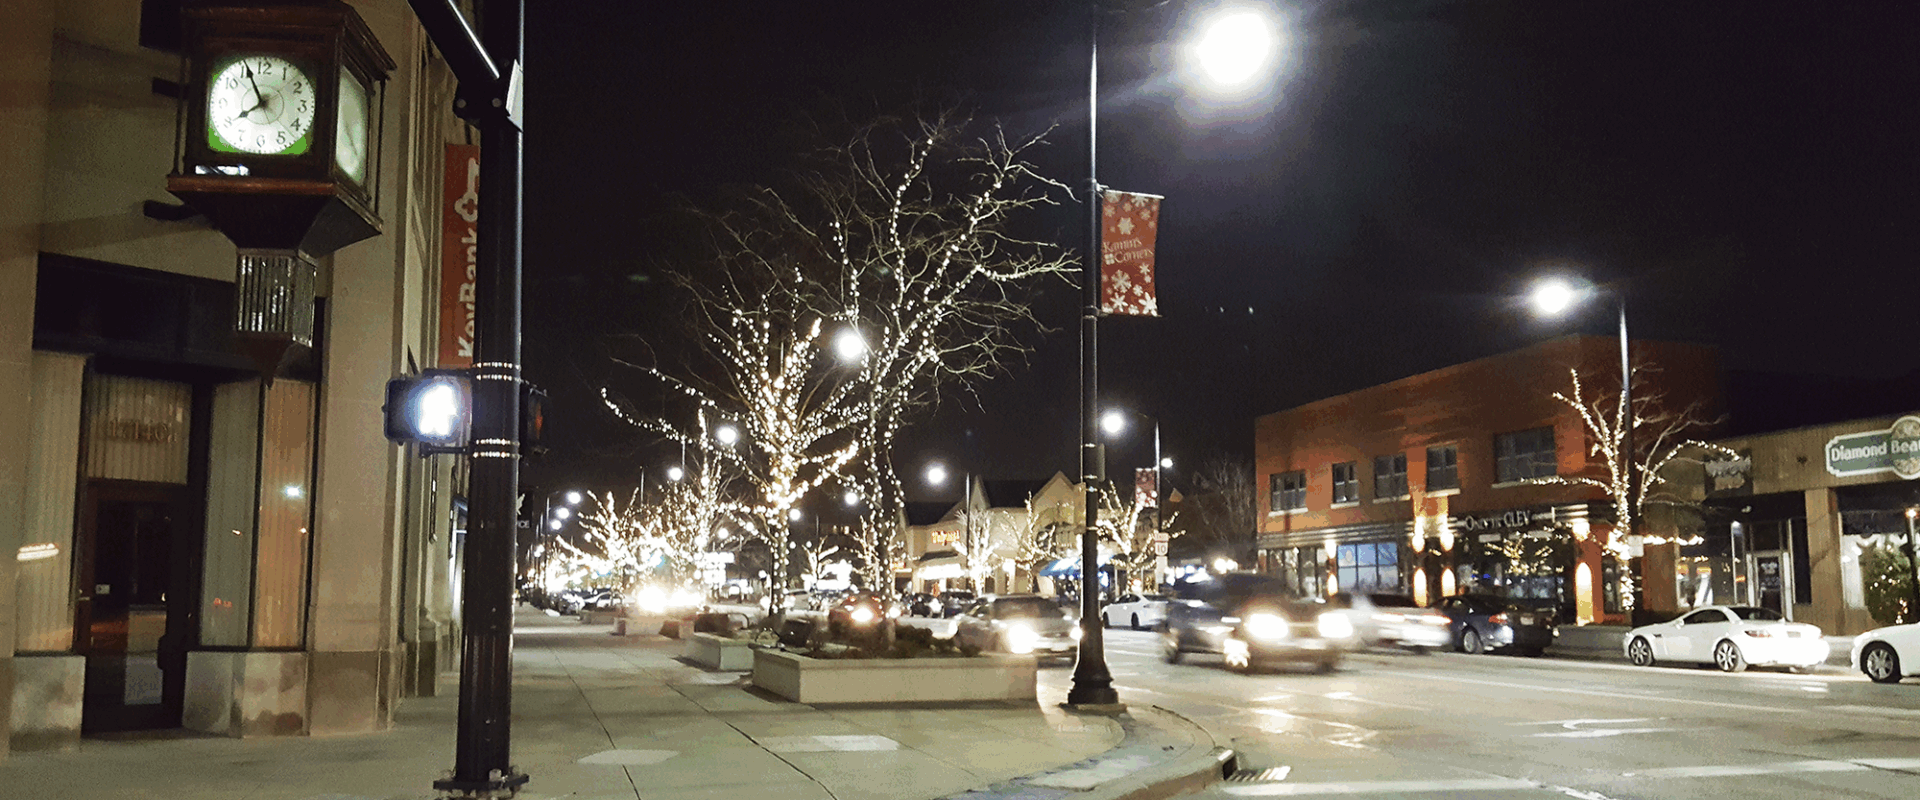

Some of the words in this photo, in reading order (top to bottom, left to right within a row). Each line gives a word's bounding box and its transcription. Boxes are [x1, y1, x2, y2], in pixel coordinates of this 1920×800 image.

[240, 65, 251, 79] 1
[258, 61, 272, 75] 12
[282, 67, 287, 80] 1
[225, 77, 239, 90] 10
[293, 81, 303, 94] 2
[297, 100, 307, 113] 3
[291, 118, 301, 131] 4
[238, 129, 246, 142] 7
[256, 135, 265, 147] 6
[276, 131, 286, 144] 5
[1831, 442, 1887, 461] Diamond
